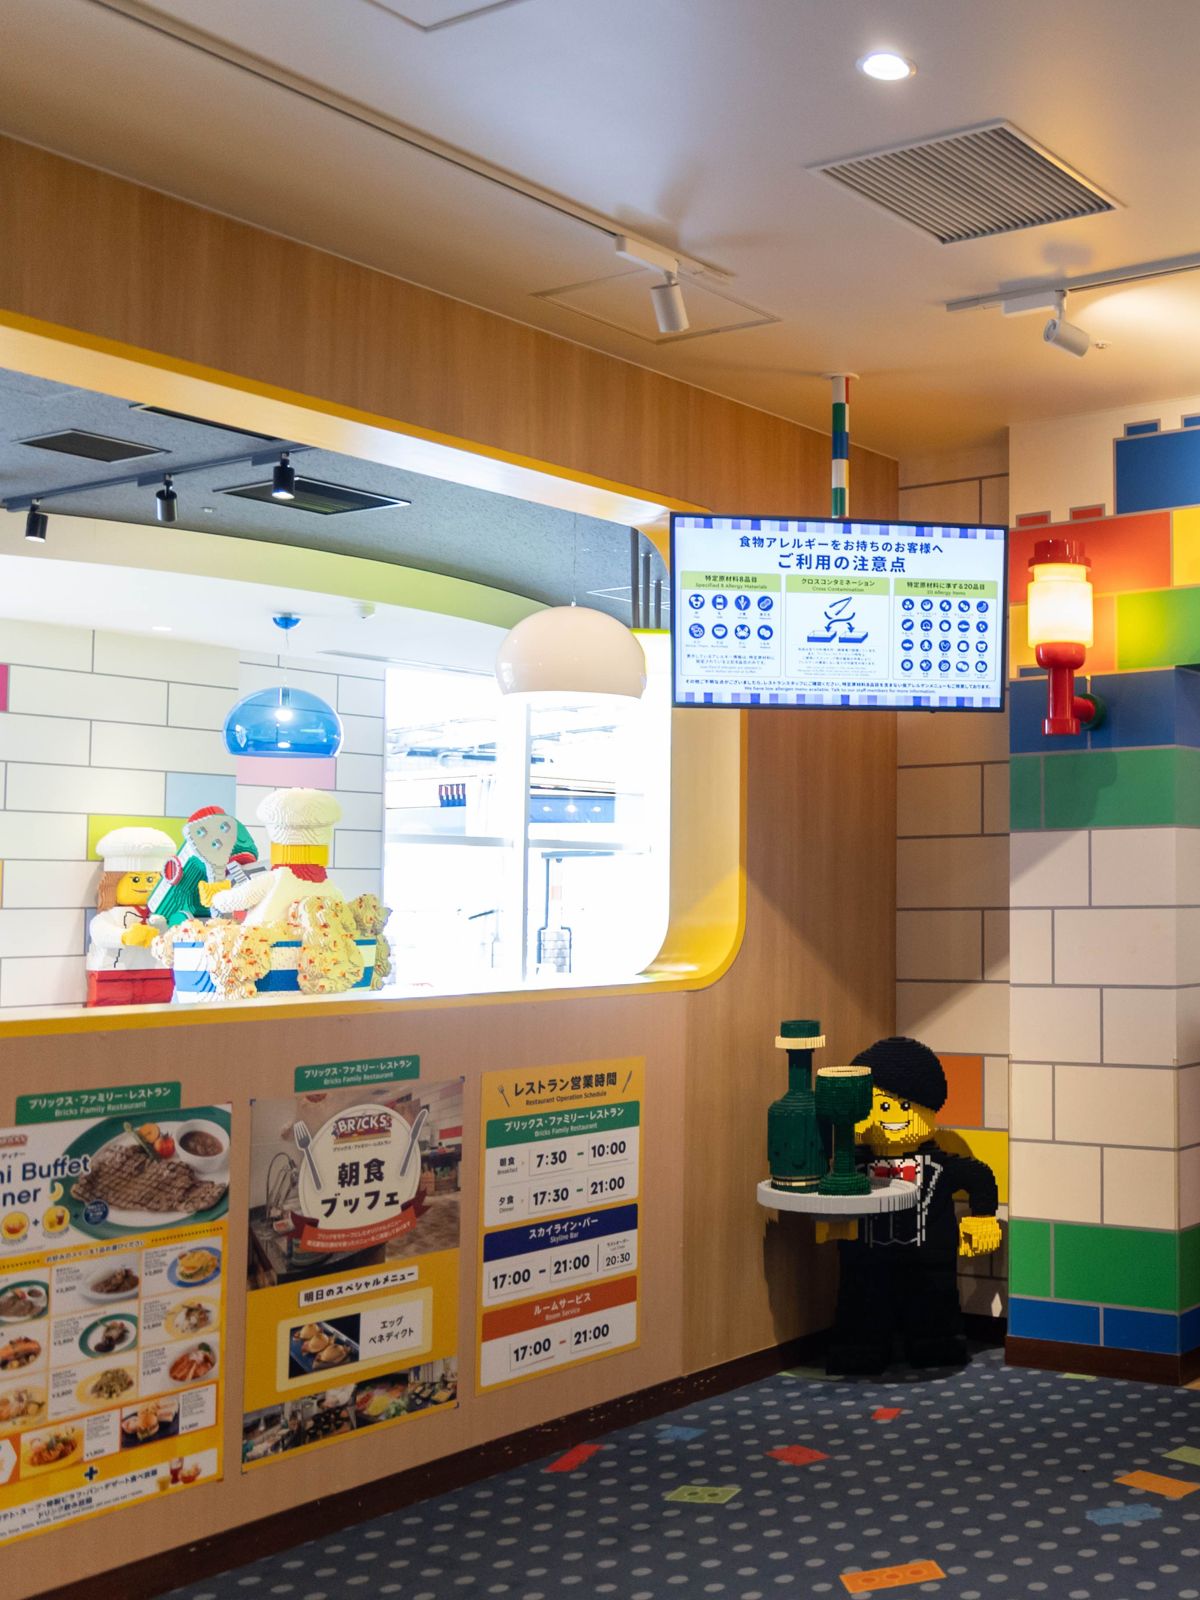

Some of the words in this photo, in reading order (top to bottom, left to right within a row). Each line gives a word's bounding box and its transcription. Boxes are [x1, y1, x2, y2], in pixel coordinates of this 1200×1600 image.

[739, 535, 943, 554] 食物アレルギーをお持ちのお客様へ
[778, 553, 906, 573] ご利用の注意点
[801, 579, 875, 587] クロスコンタミネーション
[363, 1071, 394, 1081] Restaurant
[514, 1072, 618, 1097] レストラン営業時間
[29, 1087, 171, 1109] ブリックス・ファミリー・レストラン
[54, 1106, 78, 1117] Bricks
[80, 1104, 105, 1115] Family
[107, 1101, 147, 1112] Restaurant
[526, 1097, 555, 1106] Restaurant
[556, 1093, 583, 1103] Operation
[584, 1090, 607, 1100] Schedule
[338, 1114, 386, 1132] BRICKS
[504, 1107, 625, 1133] ブリックス・ファミリー・レストラン
[570, 1122, 598, 1132] Restaurant
[499, 1156, 515, 1168] 朝食
[536, 1150, 567, 1169] 7:30
[591, 1140, 626, 1158] 10:00
[21, 1155, 90, 1181] Buffet
[337, 1158, 385, 1188] 朝食
[2, 1188, 42, 1207] ner
[499, 1195, 514, 1206] 夕食
[533, 1187, 569, 1206] 17:30
[590, 1176, 625, 1195] 21:00
[321, 1190, 400, 1218] ブッフェ
[529, 1217, 599, 1240] スカイライン・バー
[550, 1234, 569, 1244] Skyline
[569, 1232, 579, 1240] Bar
[492, 1268, 531, 1290] 17:00
[553, 1254, 590, 1275] 21:00
[605, 1252, 631, 1267] 20:30
[304, 1272, 415, 1302] 明日のスペシャルメニュー
[533, 1292, 592, 1316] ルームサービス
[380, 1316, 404, 1329] エッグ
[368, 1328, 415, 1345] ベネディクト
[513, 1338, 551, 1362] 17:00
[574, 1323, 610, 1345] 21:00
